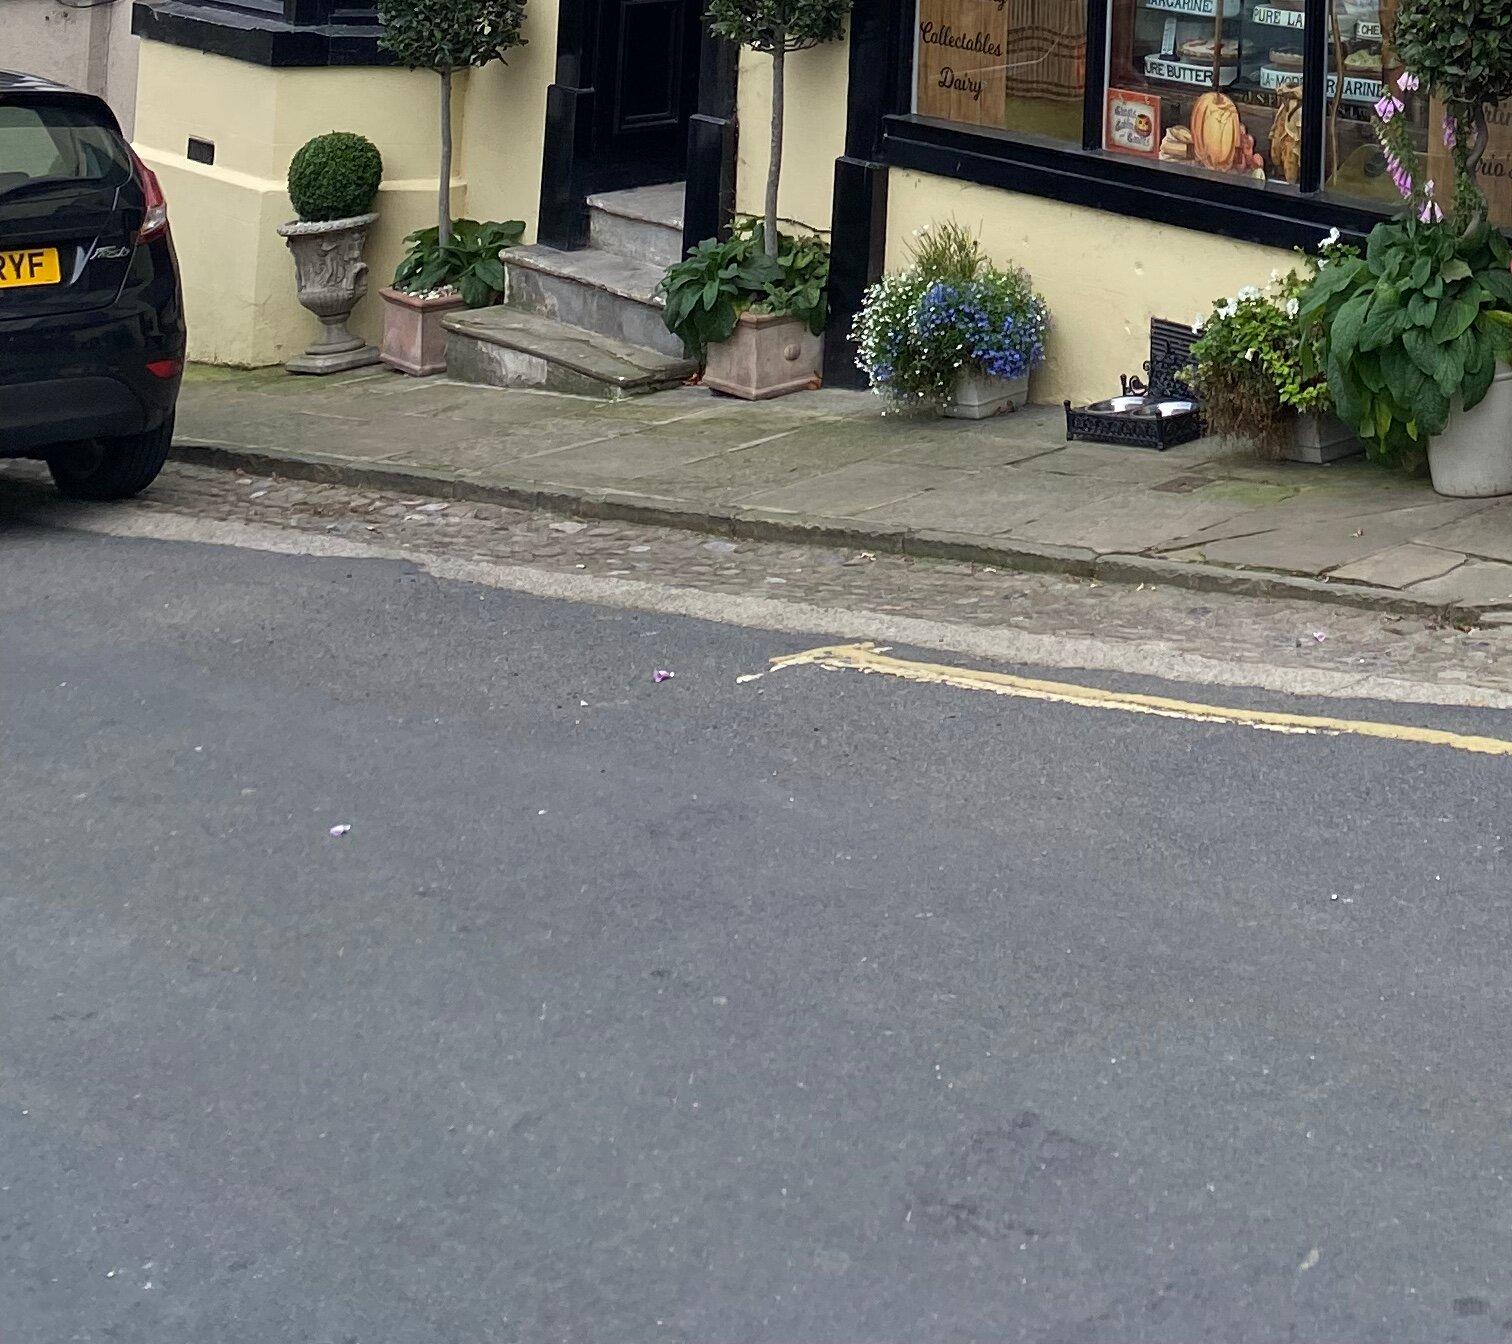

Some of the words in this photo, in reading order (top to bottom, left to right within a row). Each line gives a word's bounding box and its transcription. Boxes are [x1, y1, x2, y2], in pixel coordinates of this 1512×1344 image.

[1287, 11, 1304, 28] LA
[919, 20, 1004, 58] Collectables
[938, 66, 985, 102] Dairy
[1145, 62, 1165, 77] URE
[1166, 63, 1214, 83] BUTTER
